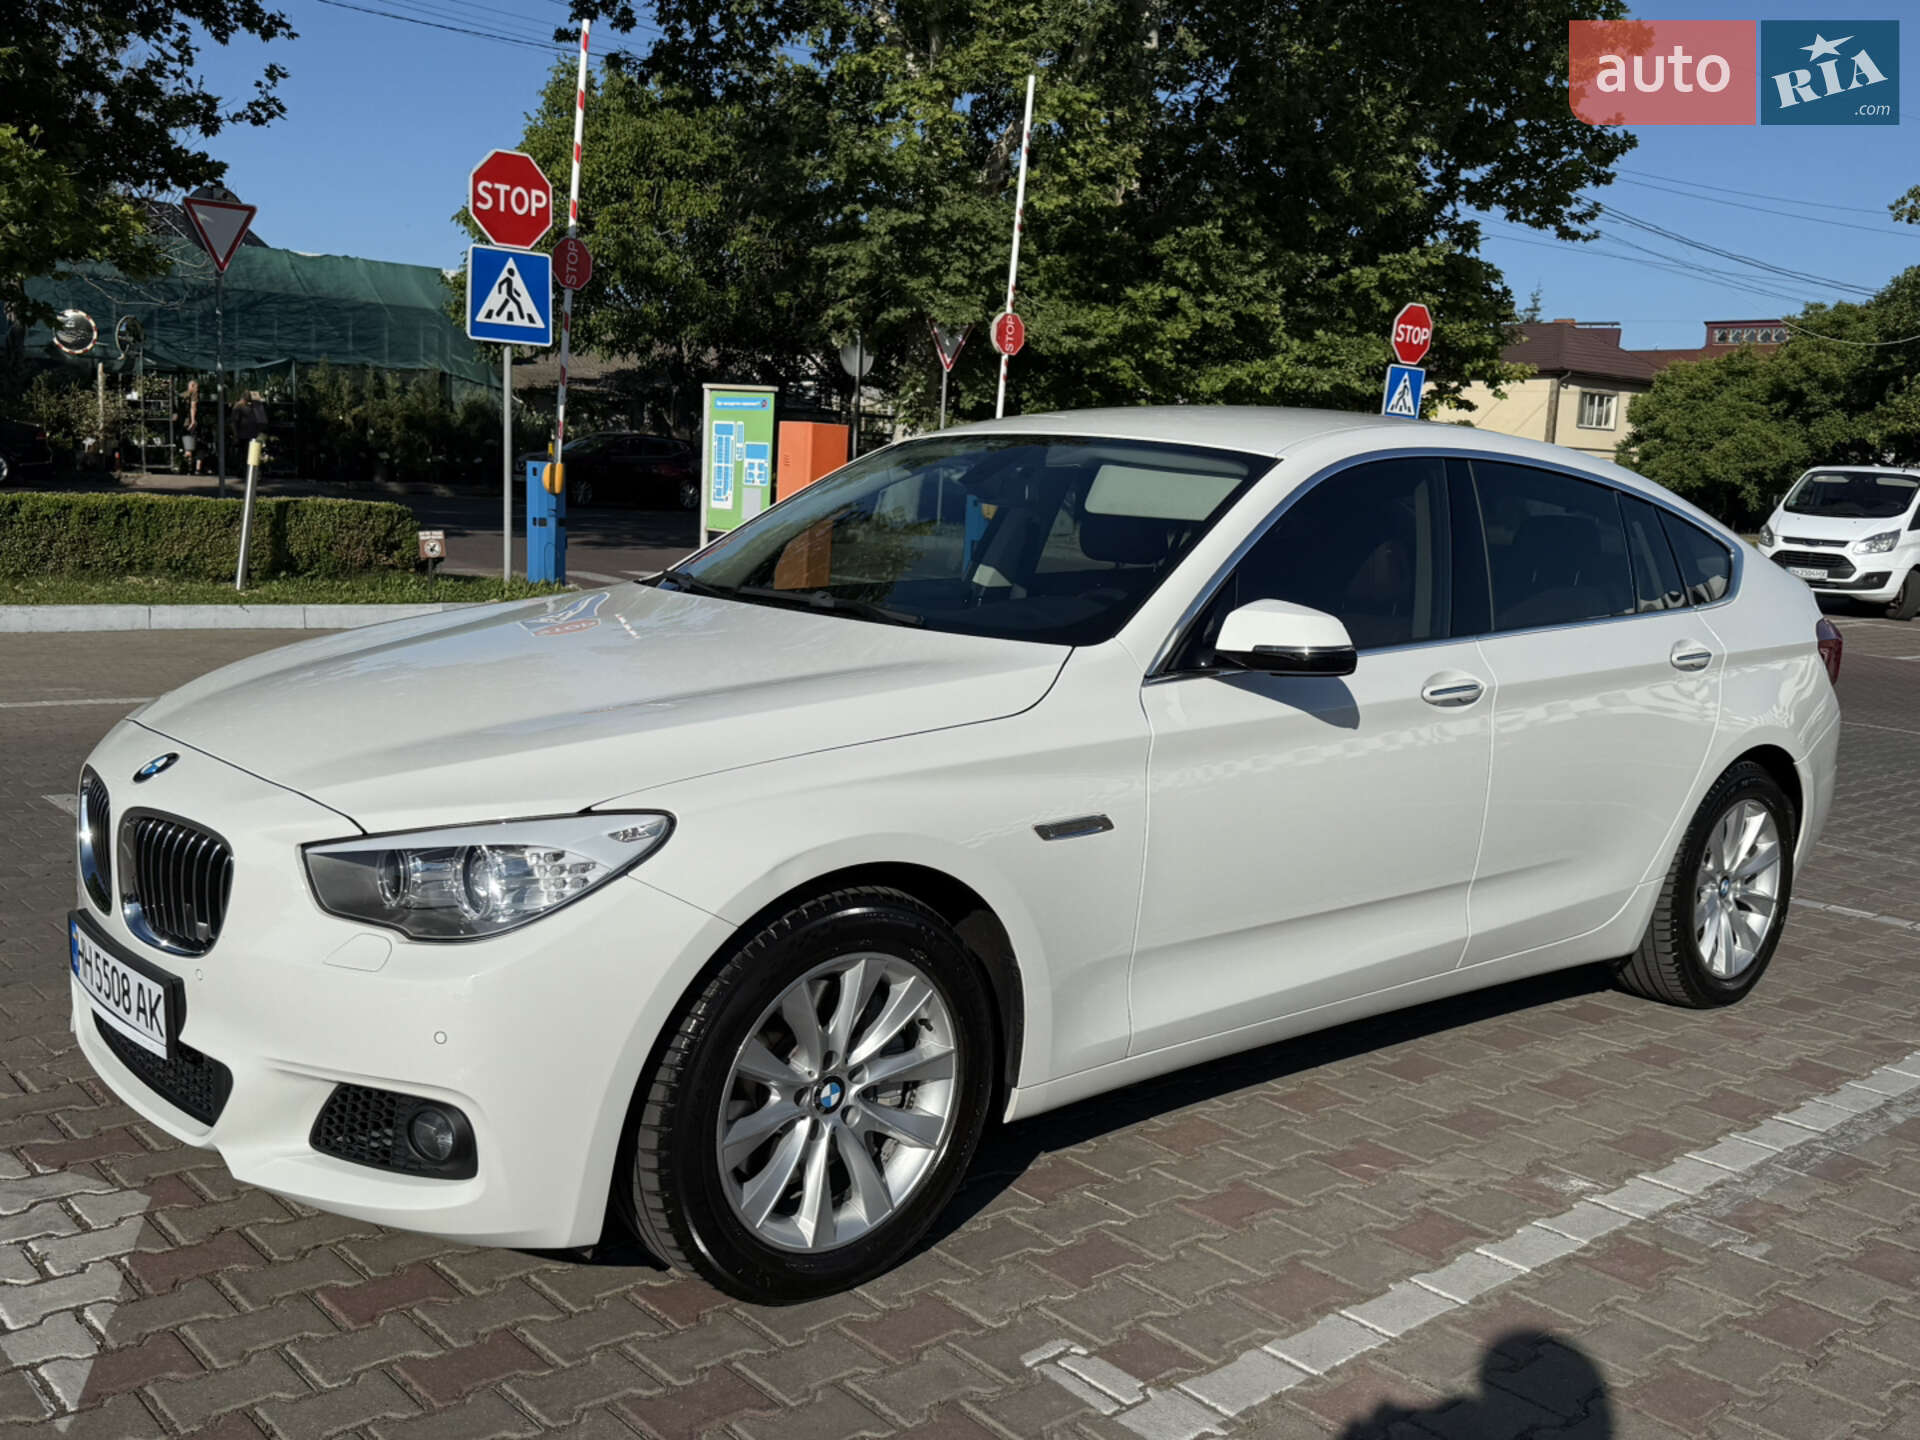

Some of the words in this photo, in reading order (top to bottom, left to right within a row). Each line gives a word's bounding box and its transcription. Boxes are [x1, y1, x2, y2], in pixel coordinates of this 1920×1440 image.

[476, 180, 548, 217] STOP
[566, 241, 578, 285] STOP
[1005, 315, 1016, 353] STOP
[1396, 324, 1430, 345] STOP
